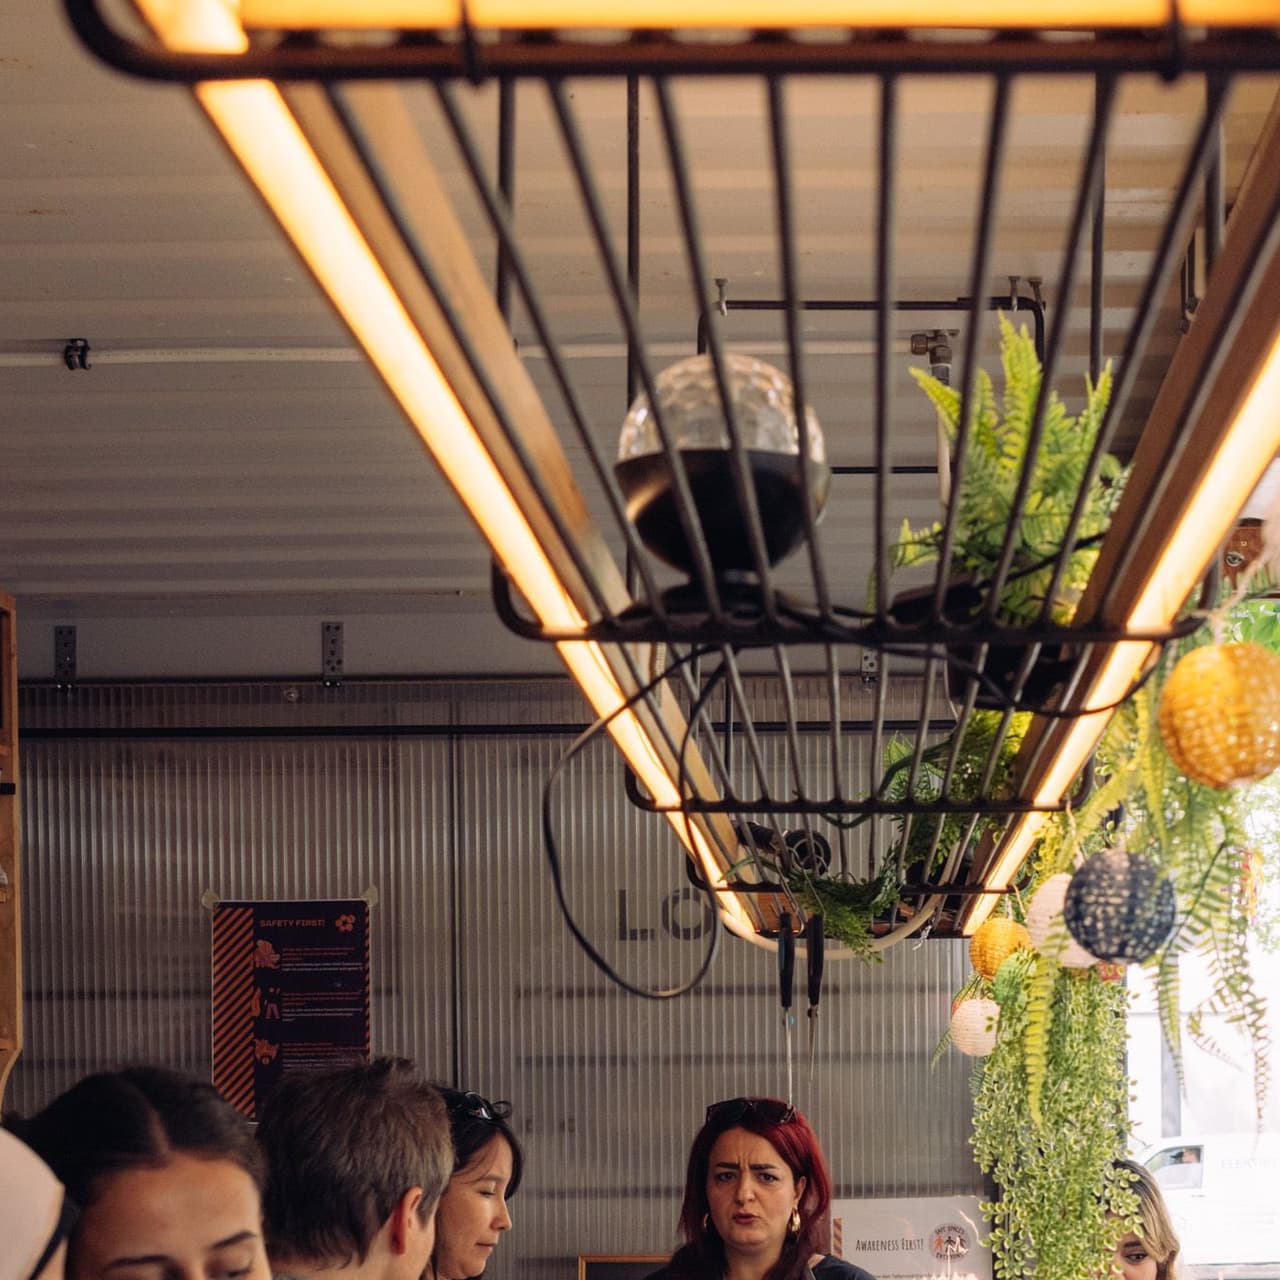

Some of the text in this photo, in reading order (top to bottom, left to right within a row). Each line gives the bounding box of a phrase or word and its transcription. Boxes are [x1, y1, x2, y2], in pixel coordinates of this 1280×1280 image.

[260, 918, 325, 928] SAFETY FIRST!
[855, 1237, 924, 1252] AWARENESS FIRST!
